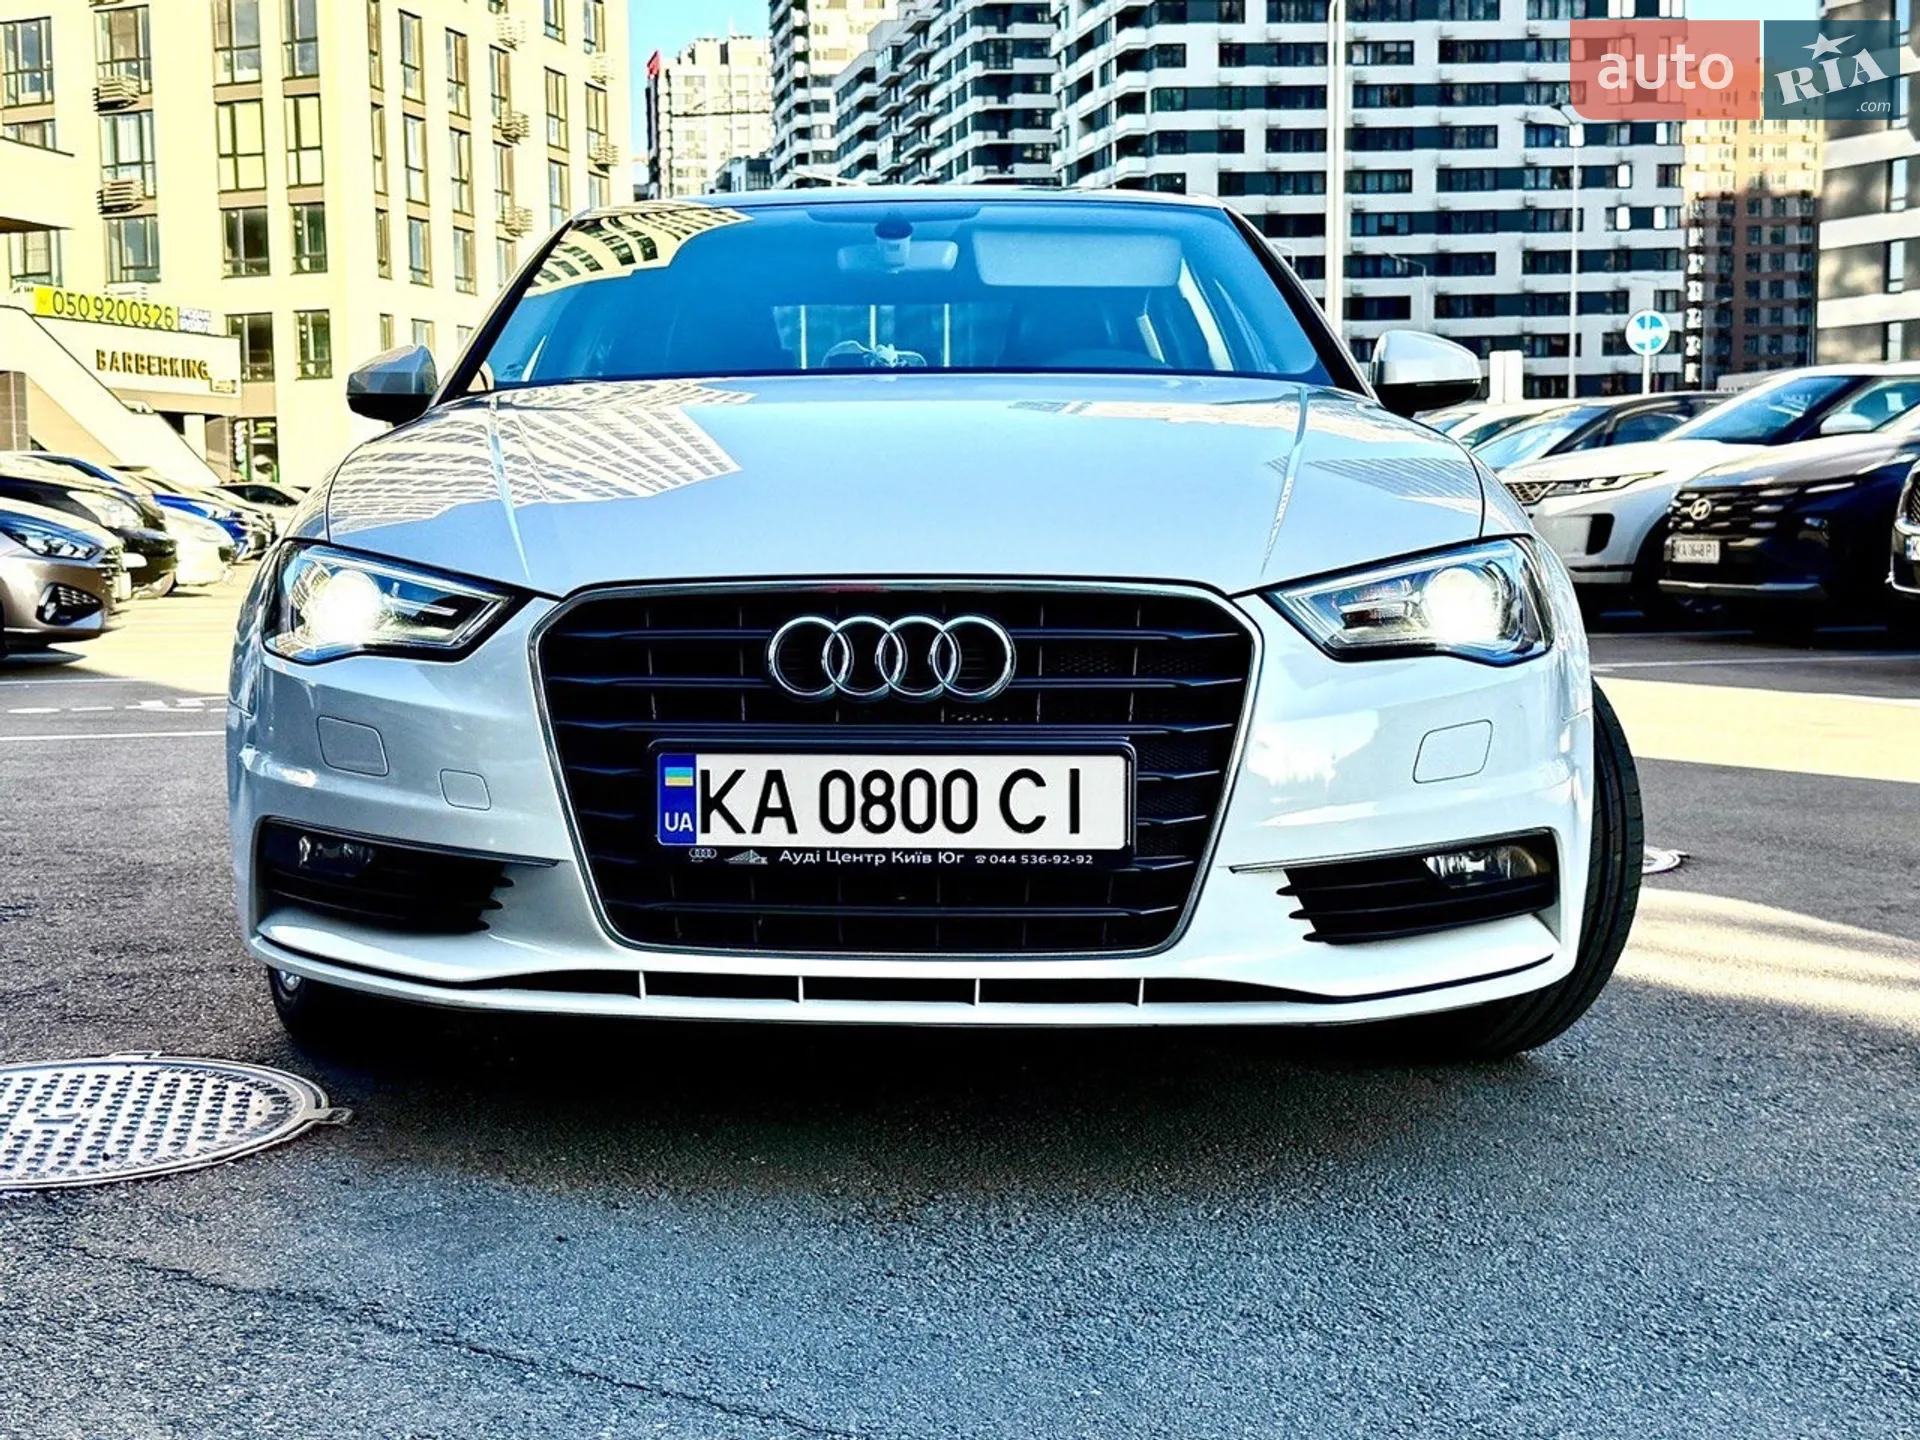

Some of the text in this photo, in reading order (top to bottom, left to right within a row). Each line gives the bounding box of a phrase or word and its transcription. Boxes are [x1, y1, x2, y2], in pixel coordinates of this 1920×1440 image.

[95, 349, 210, 380] BARBERKING
[700, 768, 1080, 835] KA 0800 CI
[664, 812, 694, 832] UA
[779, 850, 965, 866] Ауді Центр Київ Юг
[989, 854, 1094, 864] 044 536-92-92
